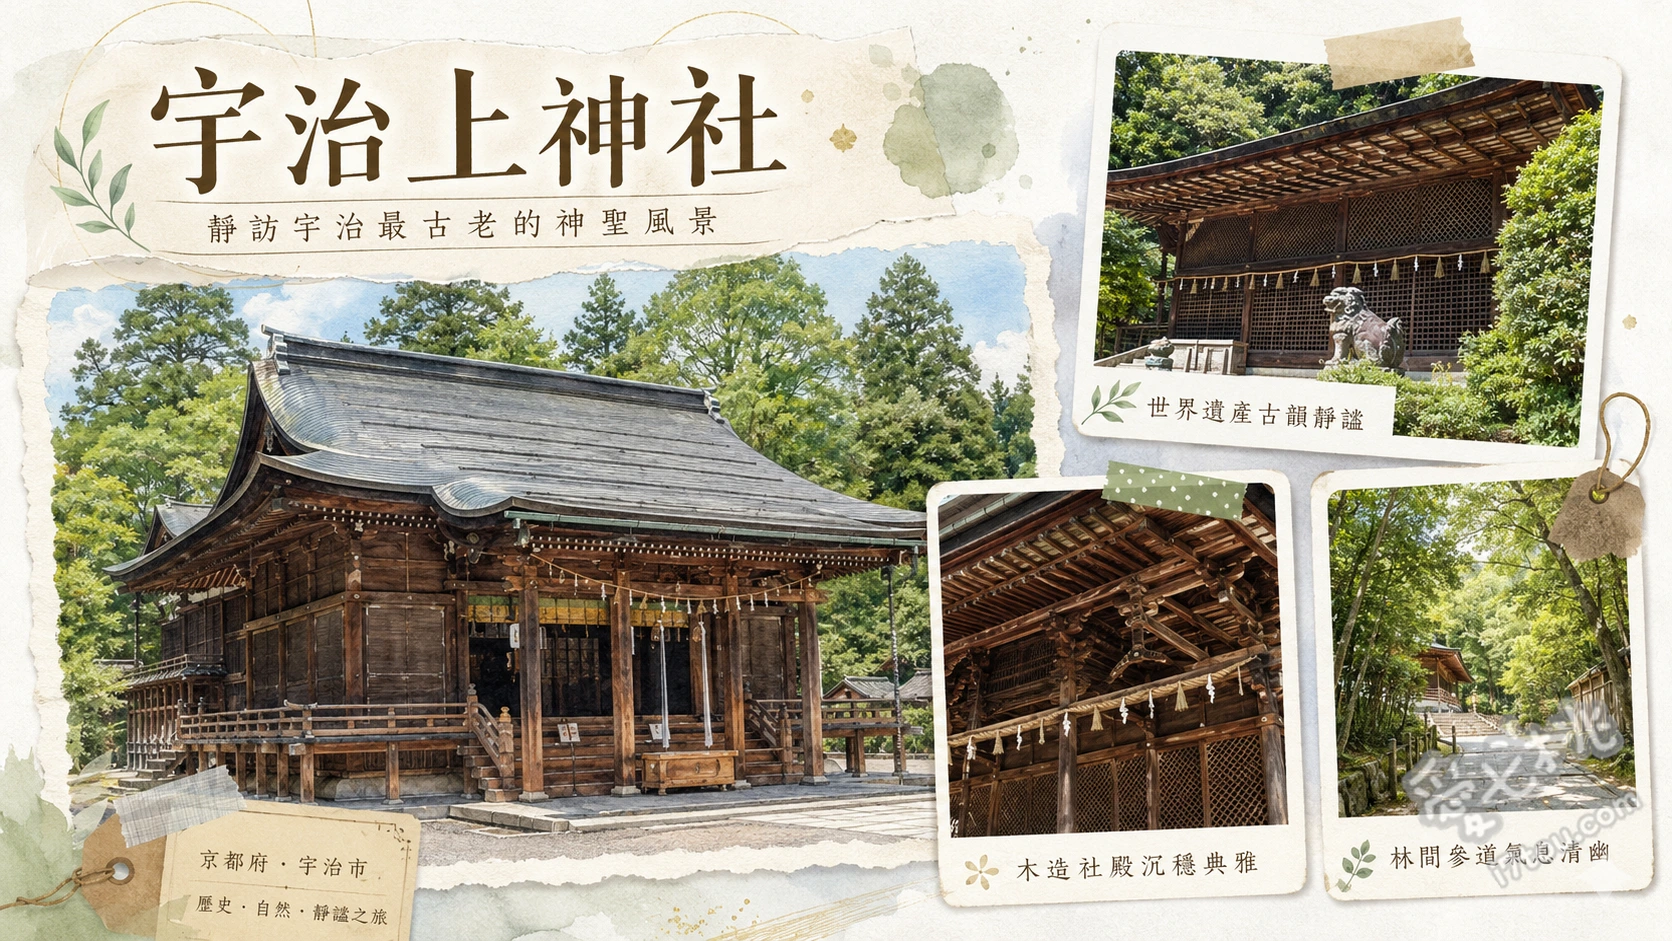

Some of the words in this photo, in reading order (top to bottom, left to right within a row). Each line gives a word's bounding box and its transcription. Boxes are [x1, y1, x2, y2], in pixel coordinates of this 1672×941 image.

[151, 66, 787, 195] 宇治上神社
[207, 206, 717, 243] 靜訪宇治最古老的神聖風景
[1147, 396, 1364, 431] 世界遺產古韻靜謐
[1017, 850, 1258, 882] 木造社殿沉穩典雅
[1390, 840, 1609, 870] 林間參道氣息清幽
